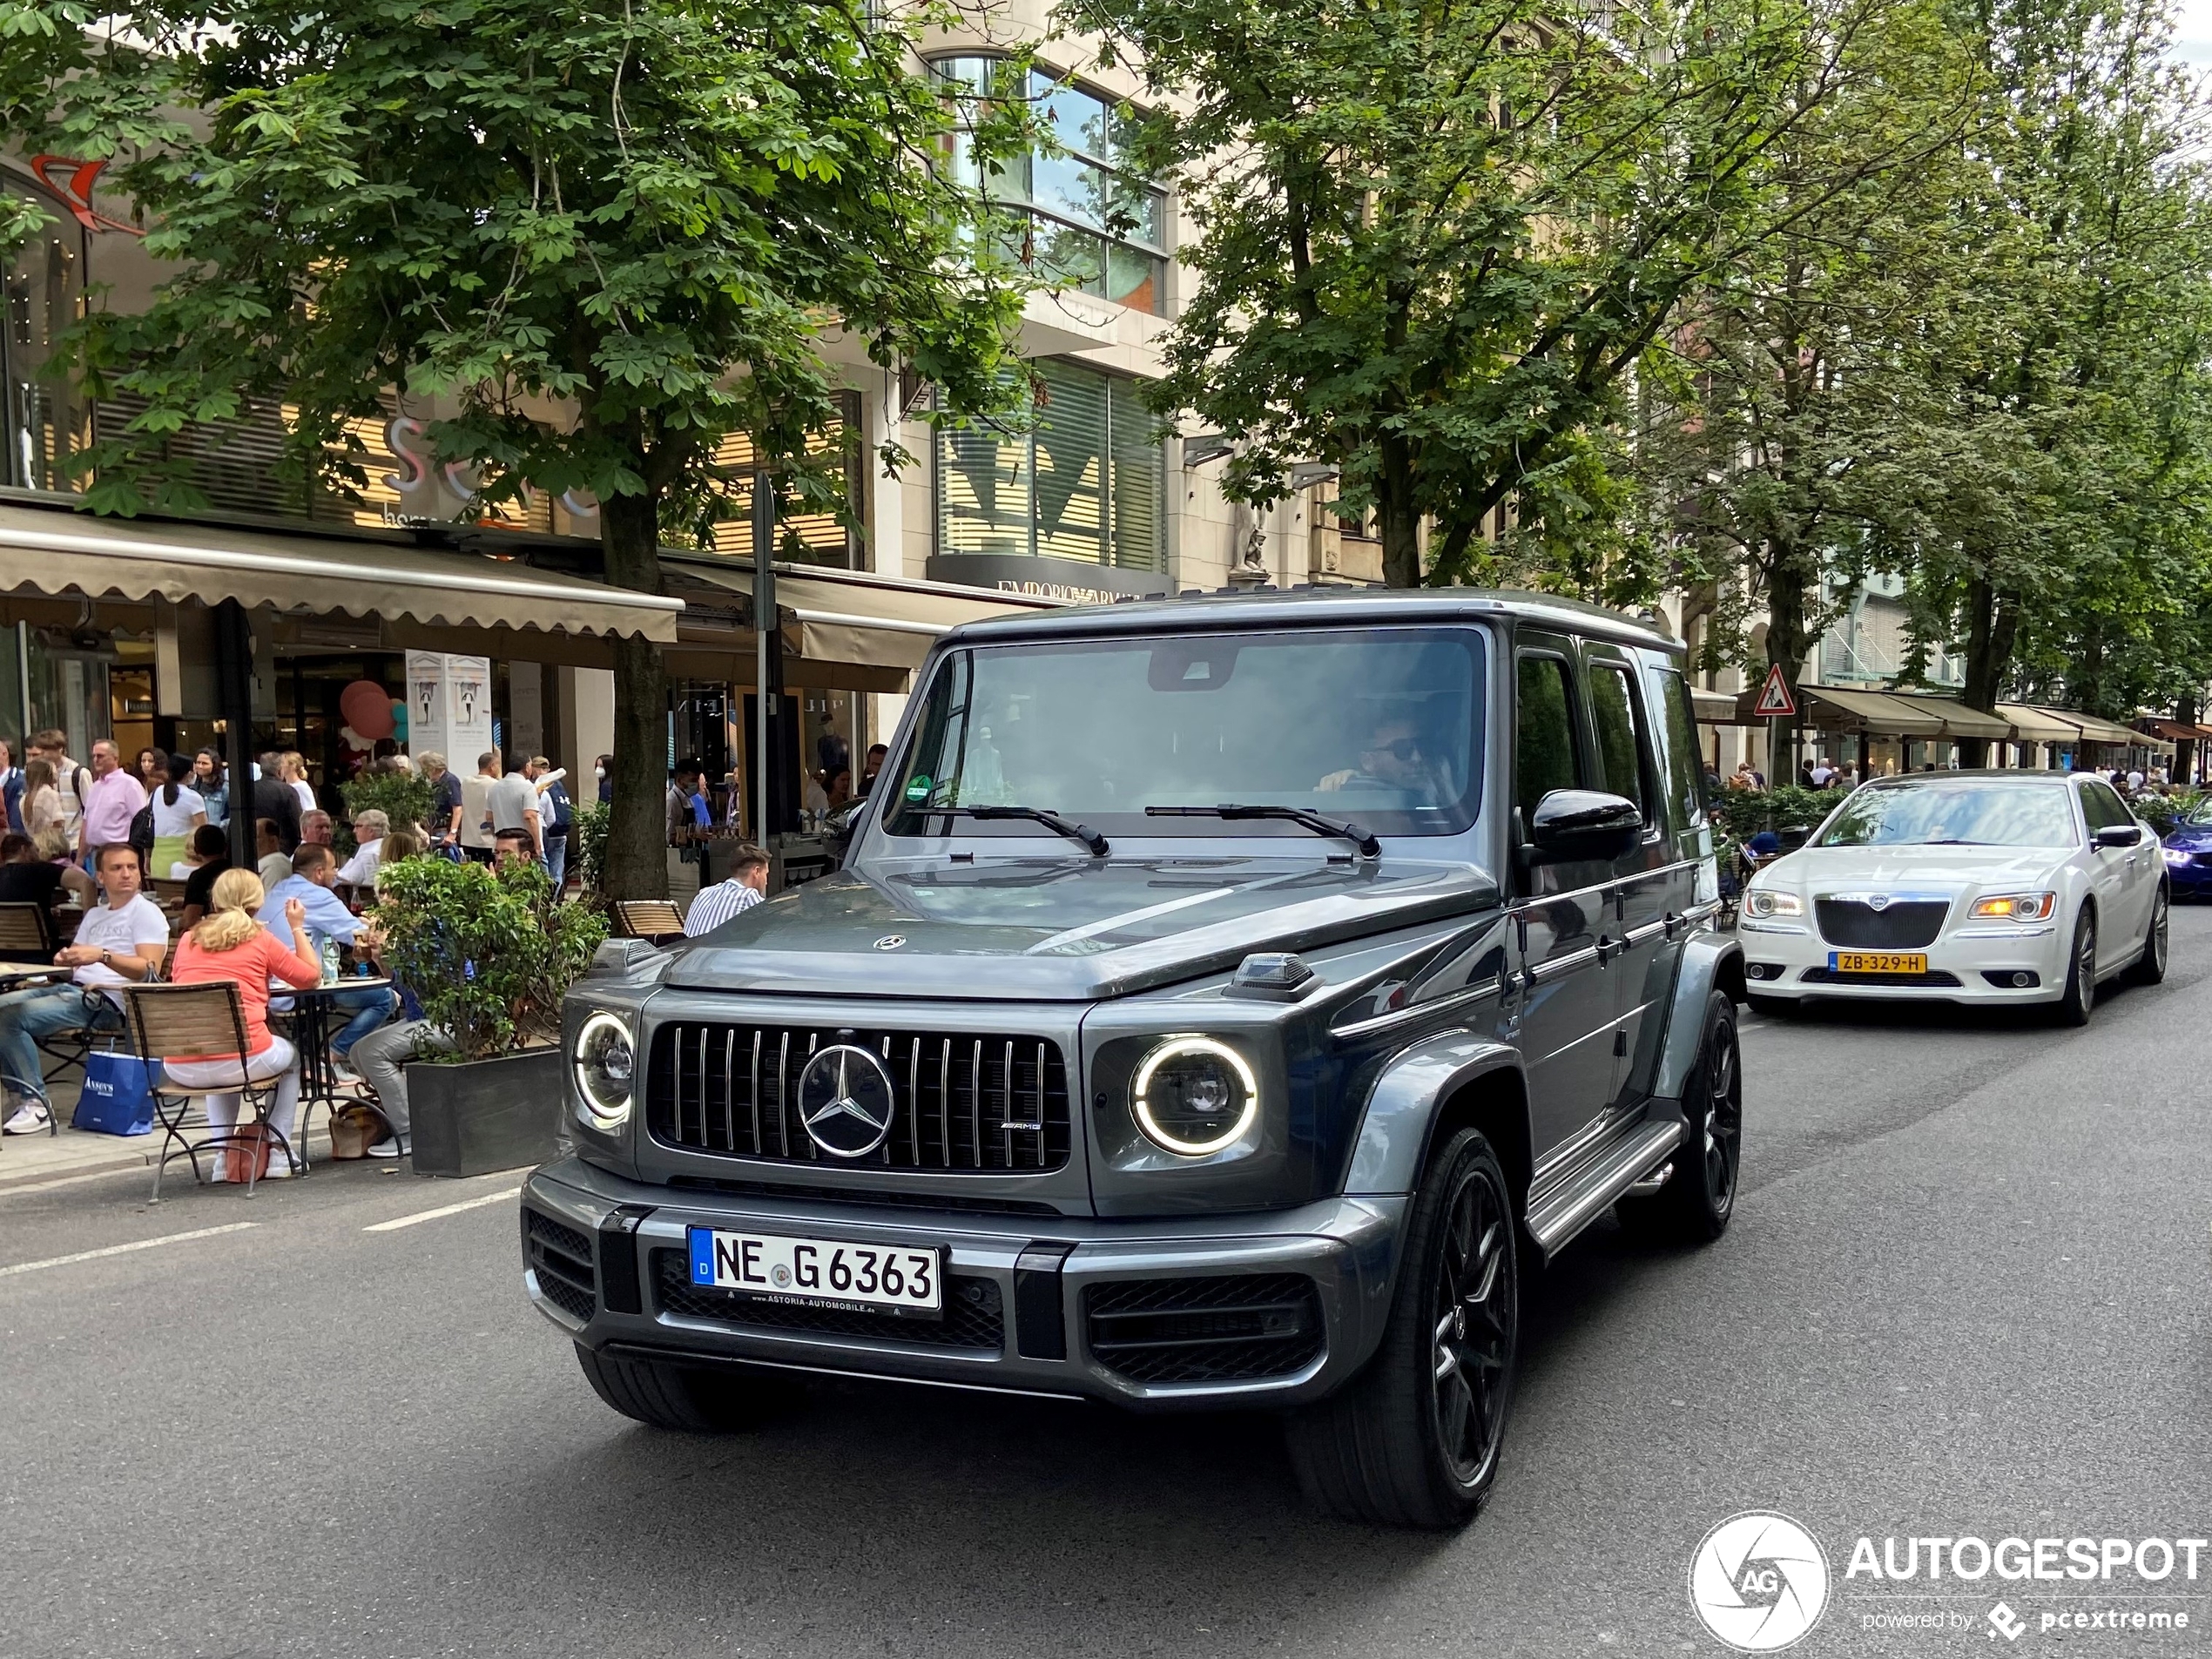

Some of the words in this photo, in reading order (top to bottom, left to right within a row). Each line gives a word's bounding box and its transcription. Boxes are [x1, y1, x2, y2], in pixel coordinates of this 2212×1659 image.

[1843, 955, 1919, 971] ZB-329-H
[699, 1262, 709, 1275] D
[715, 1238, 766, 1283] NE
[793, 1244, 819, 1289] G
[829, 1248, 931, 1299] 6363
